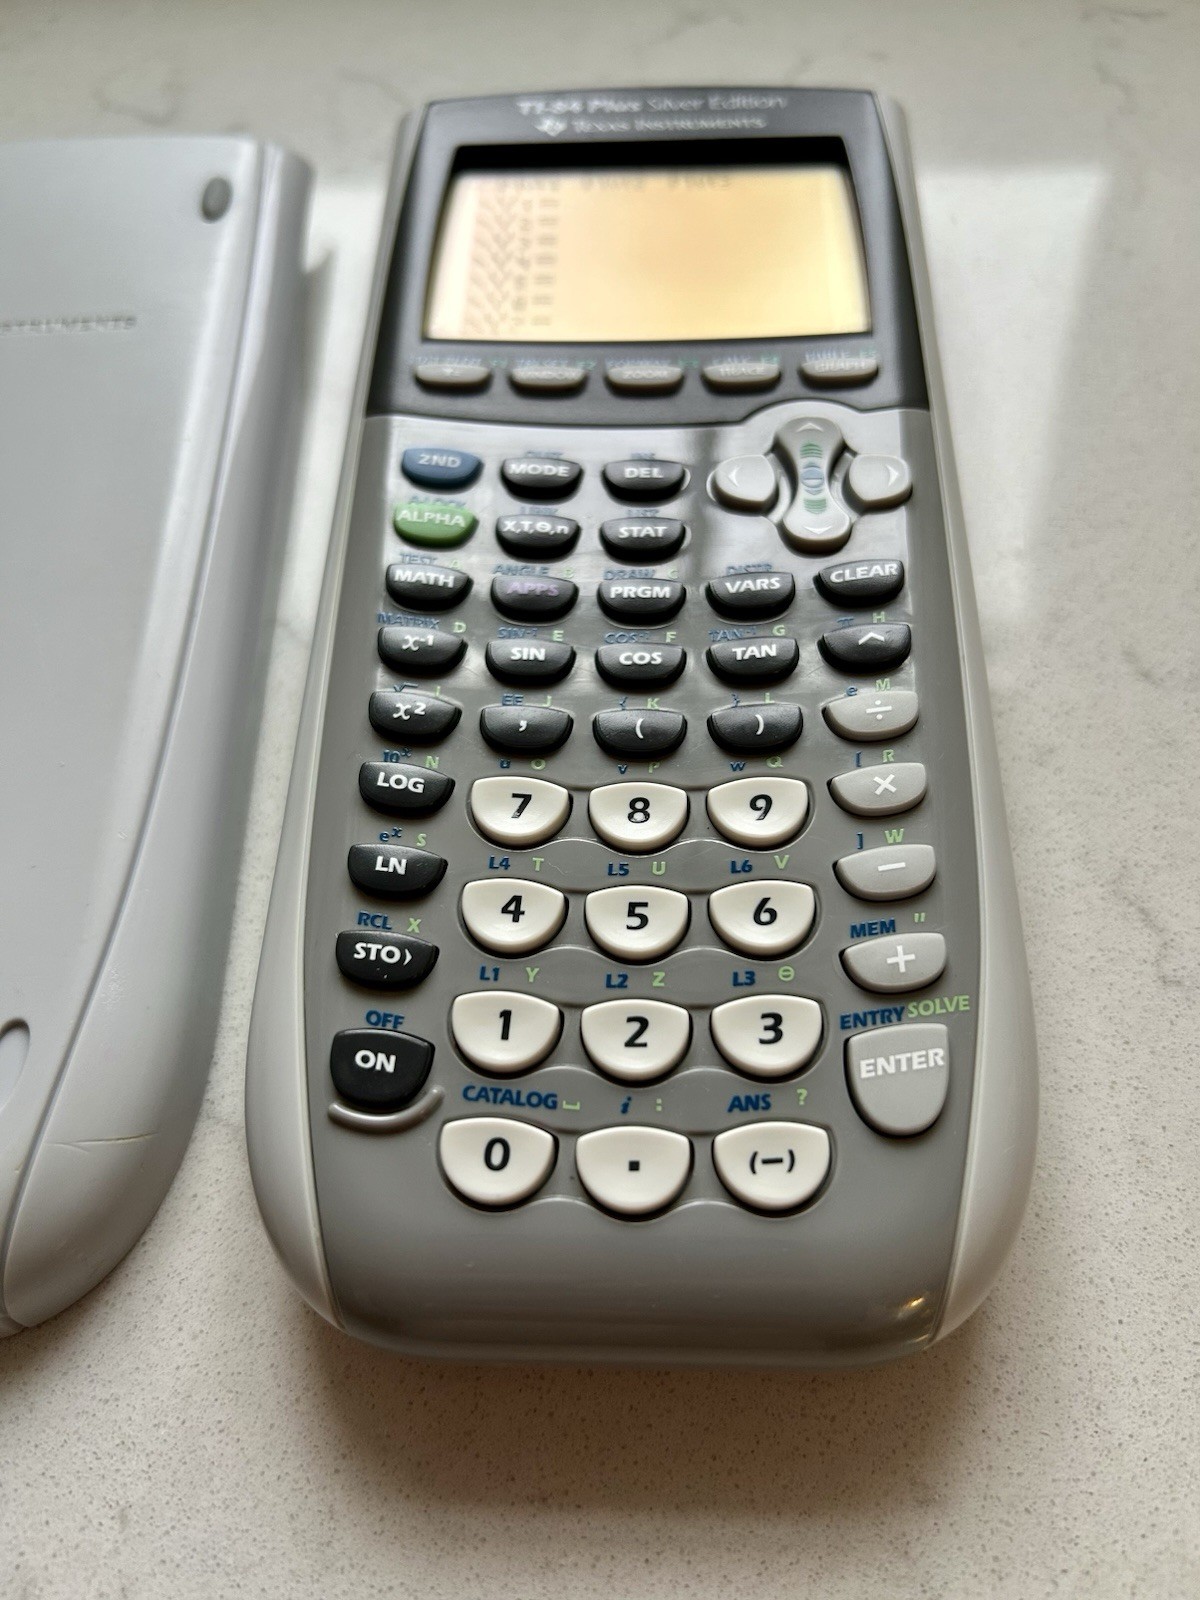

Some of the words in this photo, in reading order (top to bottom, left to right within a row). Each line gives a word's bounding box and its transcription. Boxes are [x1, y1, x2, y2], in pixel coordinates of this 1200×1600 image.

[587, 98, 642, 113] Plus
[645, 95, 704, 111] Silver
[708, 92, 787, 110] Edition
[419, 453, 462, 468] 2ND
[509, 463, 571, 477] MODE
[623, 467, 664, 478] DEL
[397, 509, 466, 528] ALPHA
[618, 526, 669, 539] STAT
[394, 569, 455, 588] MATH
[830, 562, 899, 583] CLEAR
[506, 582, 560, 597] APPS
[610, 586, 672, 599] PRGM
[725, 577, 781, 594] VARS
[873, 611, 886, 623] H
[453, 621, 467, 633] D
[552, 630, 564, 641] E
[772, 625, 785, 636] G
[666, 631, 677, 643] F
[510, 647, 546, 662] SIN
[619, 651, 663, 666] COS
[732, 644, 777, 661] TAN
[875, 678, 892, 692] M
[502, 694, 524, 706] EE
[647, 698, 659, 710] K
[764, 692, 775, 704] L
[424, 756, 440, 769] N
[766, 757, 784, 769] Q
[882, 749, 895, 763] R
[648, 761, 661, 774] P
[377, 771, 425, 794] LOG
[511, 792, 532, 819] 7
[627, 797, 651, 824] 8
[749, 793, 773, 821] 9
[416, 833, 427, 848] S
[884, 828, 905, 844] W
[375, 855, 408, 876] LN
[488, 855, 511, 871] L4
[532, 857, 544, 872] T
[607, 863, 630, 877] L5
[652, 861, 666, 876] U
[730, 859, 753, 875] L6
[773, 854, 790, 870] V
[500, 895, 525, 923] 4
[625, 901, 649, 931] 5
[752, 897, 778, 926] 6
[357, 911, 393, 931] RCL
[407, 918, 422, 934] X
[849, 918, 897, 939] MEM
[479, 965, 500, 982] L1
[525, 967, 540, 983] Y
[605, 973, 629, 989] L2
[652, 972, 666, 987] Z
[732, 970, 756, 986] L3
[365, 1009, 405, 1029] OFF
[840, 1006, 905, 1031] ENTRY
[907, 995, 970, 1018] SOLVE
[498, 1009, 512, 1041] 1
[623, 1015, 650, 1049] 2
[758, 1011, 785, 1045] 3
[355, 1049, 397, 1073] ON
[859, 1047, 945, 1080] ENTER
[462, 1084, 558, 1110] CATALOG
[726, 1093, 772, 1114] ANS
[797, 1088, 808, 1105] ?
[484, 1136, 511, 1172] 0
